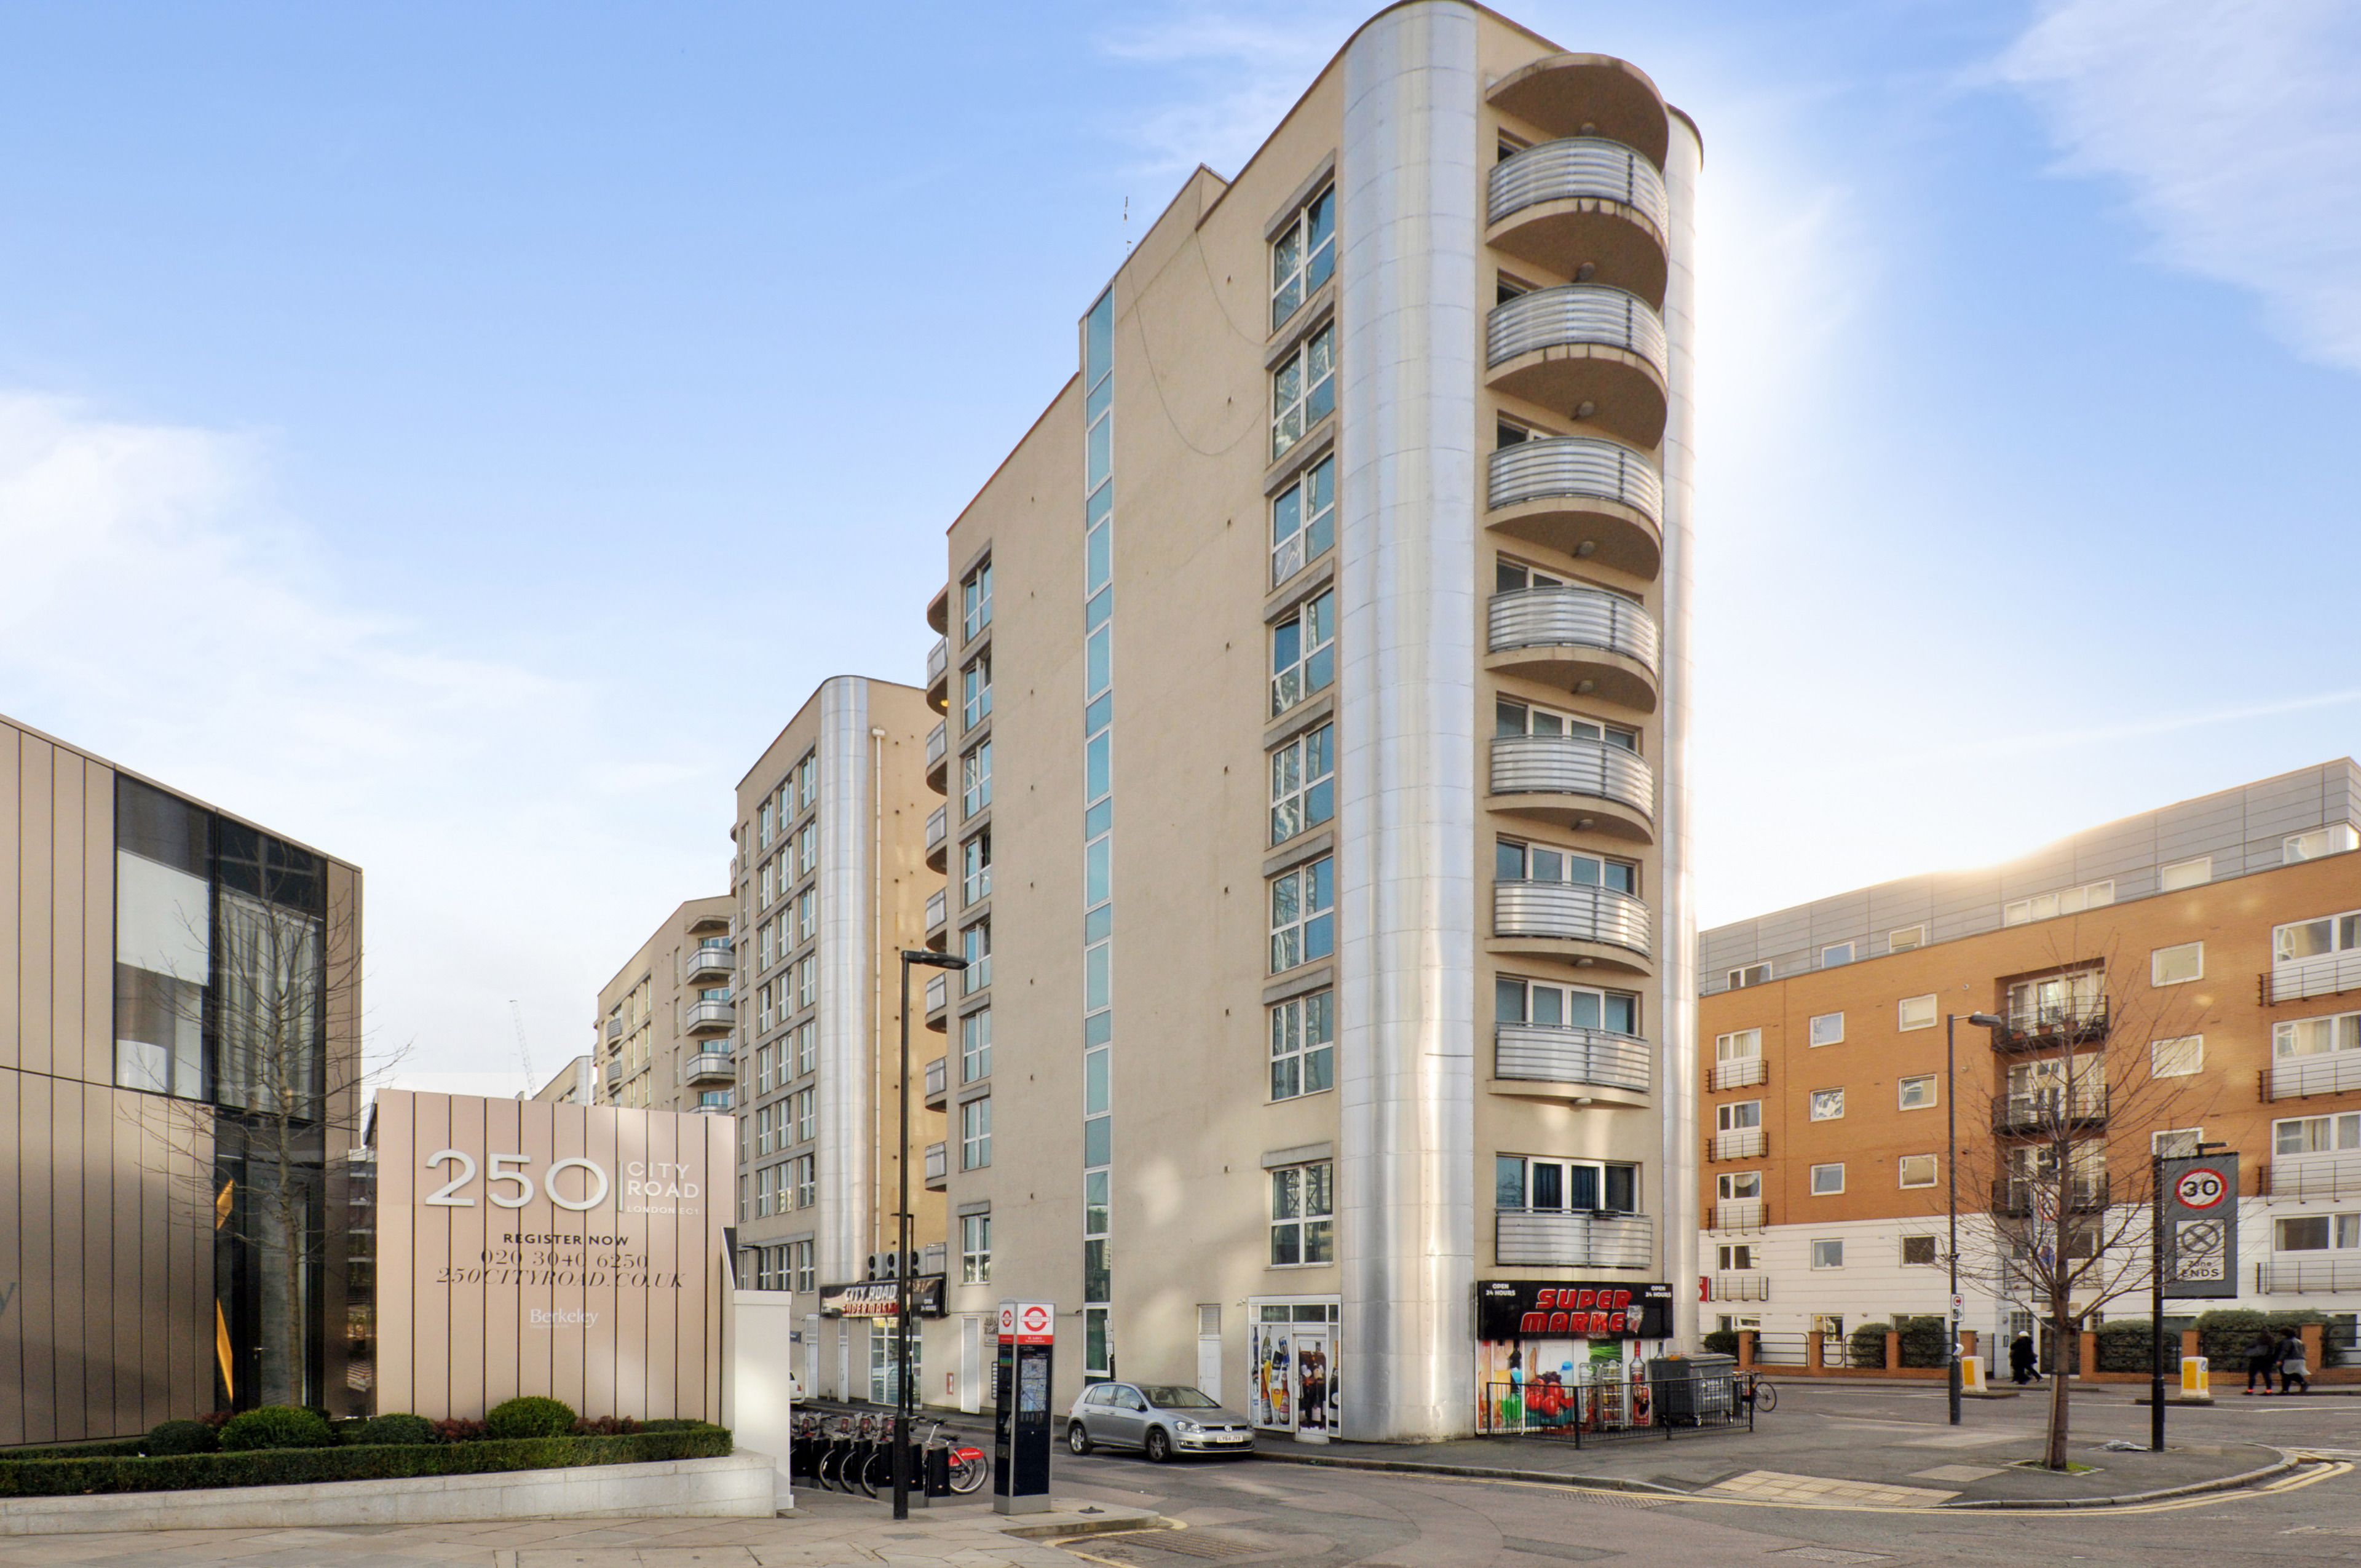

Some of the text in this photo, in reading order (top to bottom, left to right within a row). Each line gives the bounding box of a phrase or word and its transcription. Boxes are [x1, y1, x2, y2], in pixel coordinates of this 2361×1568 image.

[627, 1160, 690, 1179] CITY
[425, 1149, 609, 1211] 250
[628, 1180, 700, 1199] ROAD
[2183, 1179, 2219, 1197] 30
[627, 1205, 676, 1215] LONDON
[504, 1233, 629, 1246] REGISTER NOW
[481, 1249, 648, 1269] 020 3040 6250
[437, 1267, 686, 1288] 250CITYROAD.CO.UK
[2183, 1269, 2219, 1277] ENDS
[845, 1286, 868, 1302] CITY
[869, 1285, 898, 1301] ROAD
[1536, 1289, 1632, 1310] SUPER
[842, 1302, 900, 1314] SUPERMAR
[531, 1308, 599, 1328] Berkeley
